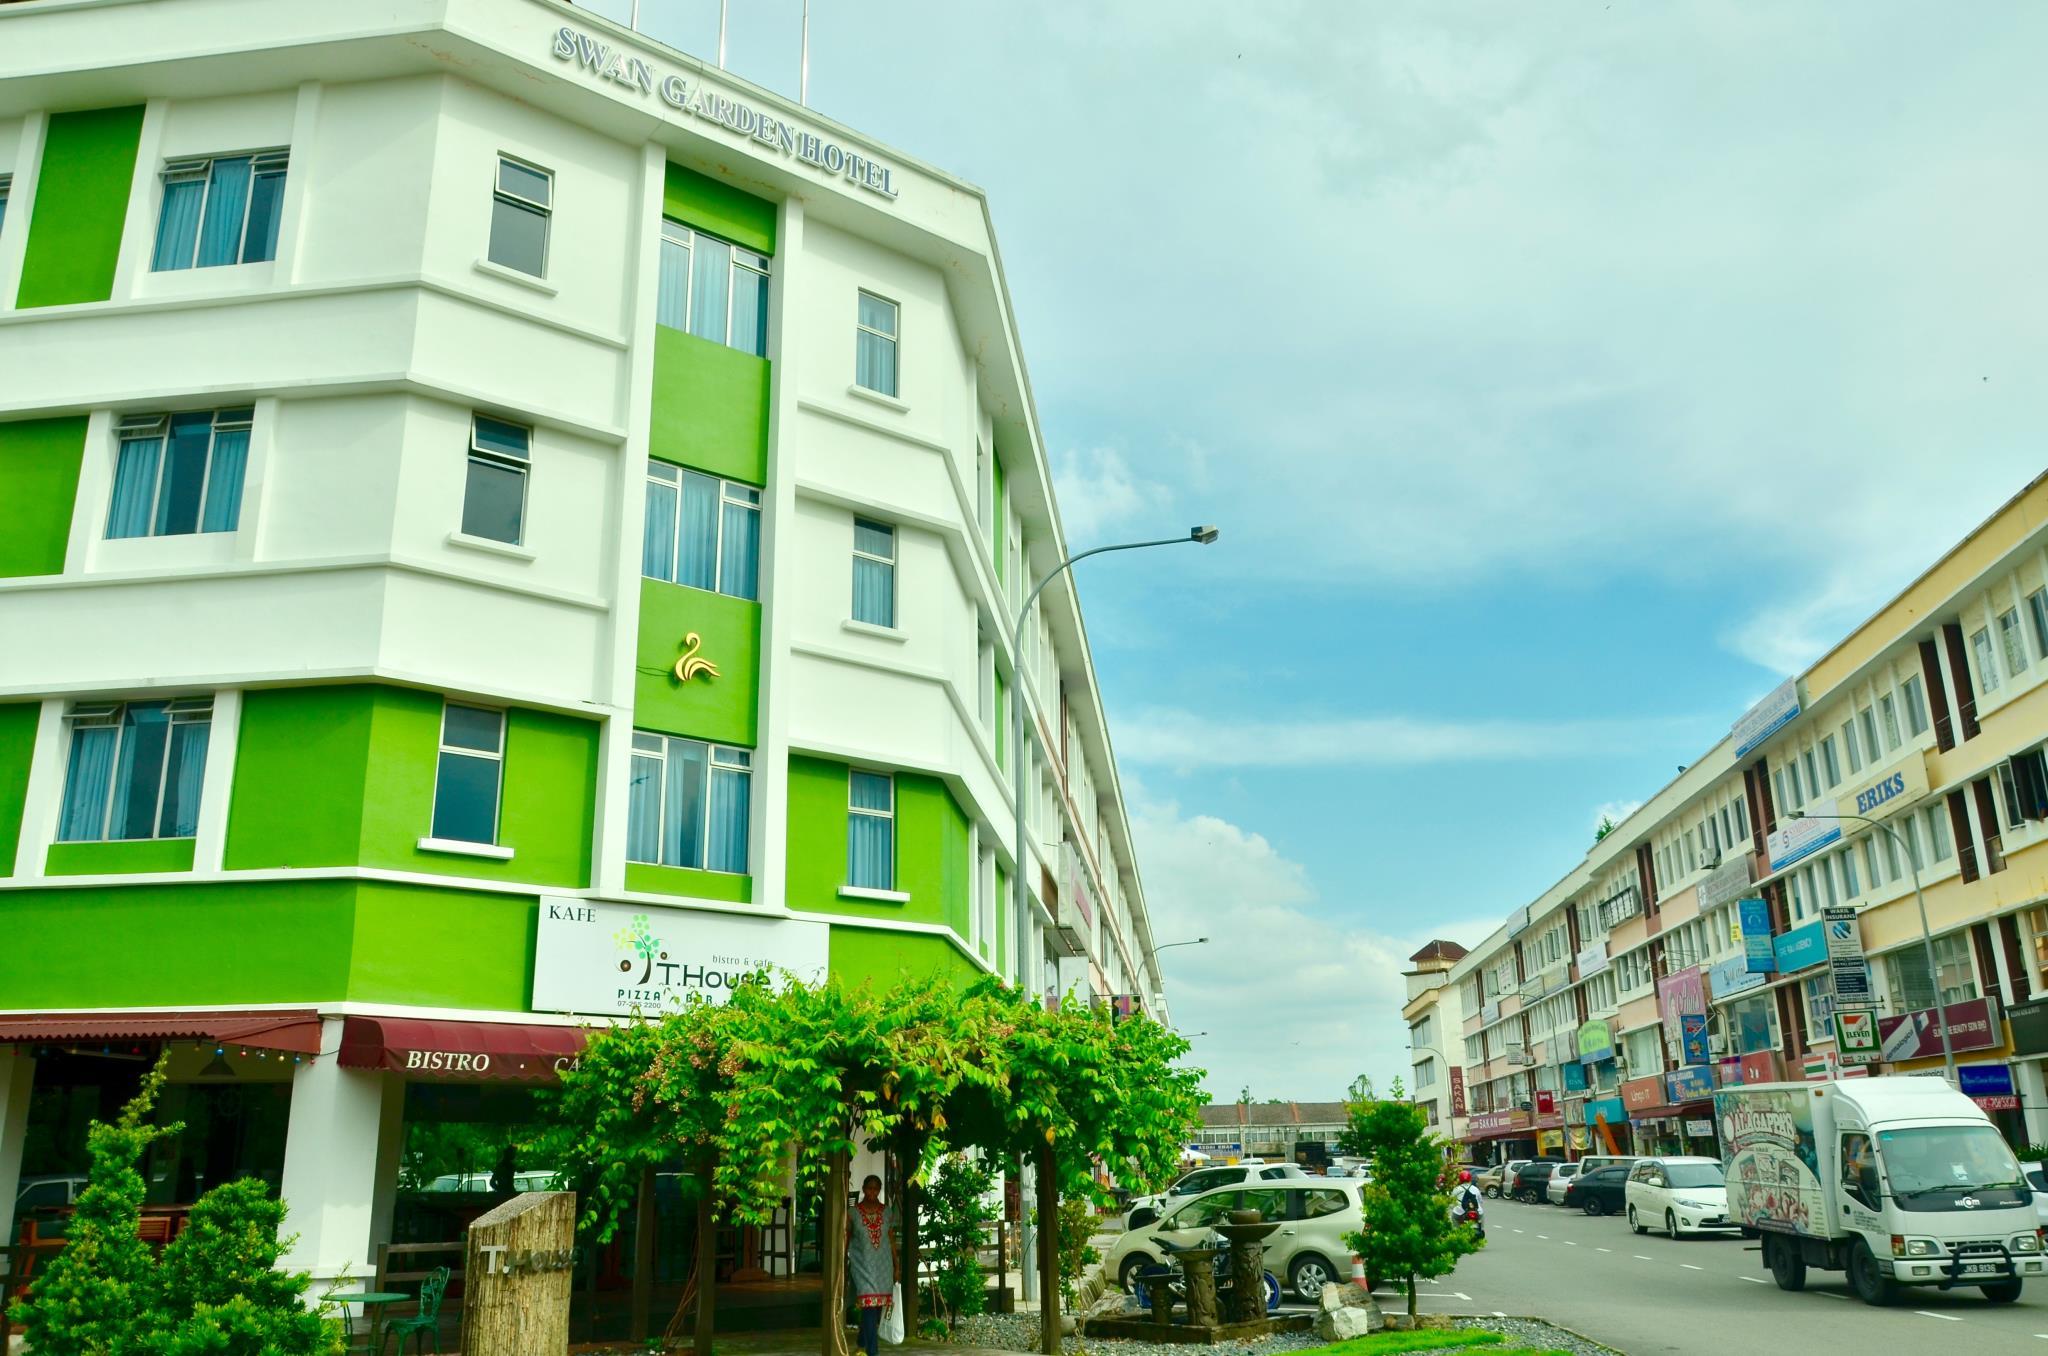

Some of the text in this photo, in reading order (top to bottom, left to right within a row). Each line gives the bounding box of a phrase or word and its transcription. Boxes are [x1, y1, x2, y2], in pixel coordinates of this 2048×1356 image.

[554, 27, 900, 199] SWAN GARDEN HOTEL
[1856, 771, 1904, 815] ERIKS
[549, 905, 596, 923] KAFE
[712, 955, 740, 966] bistro
[743, 957, 750, 966] &
[617, 989, 662, 1001] PIZZA
[406, 1050, 582, 1073] BISTRO CA
[1453, 1077, 1464, 1110] SAKAN
[1479, 1117, 1498, 1129] SAKAN
